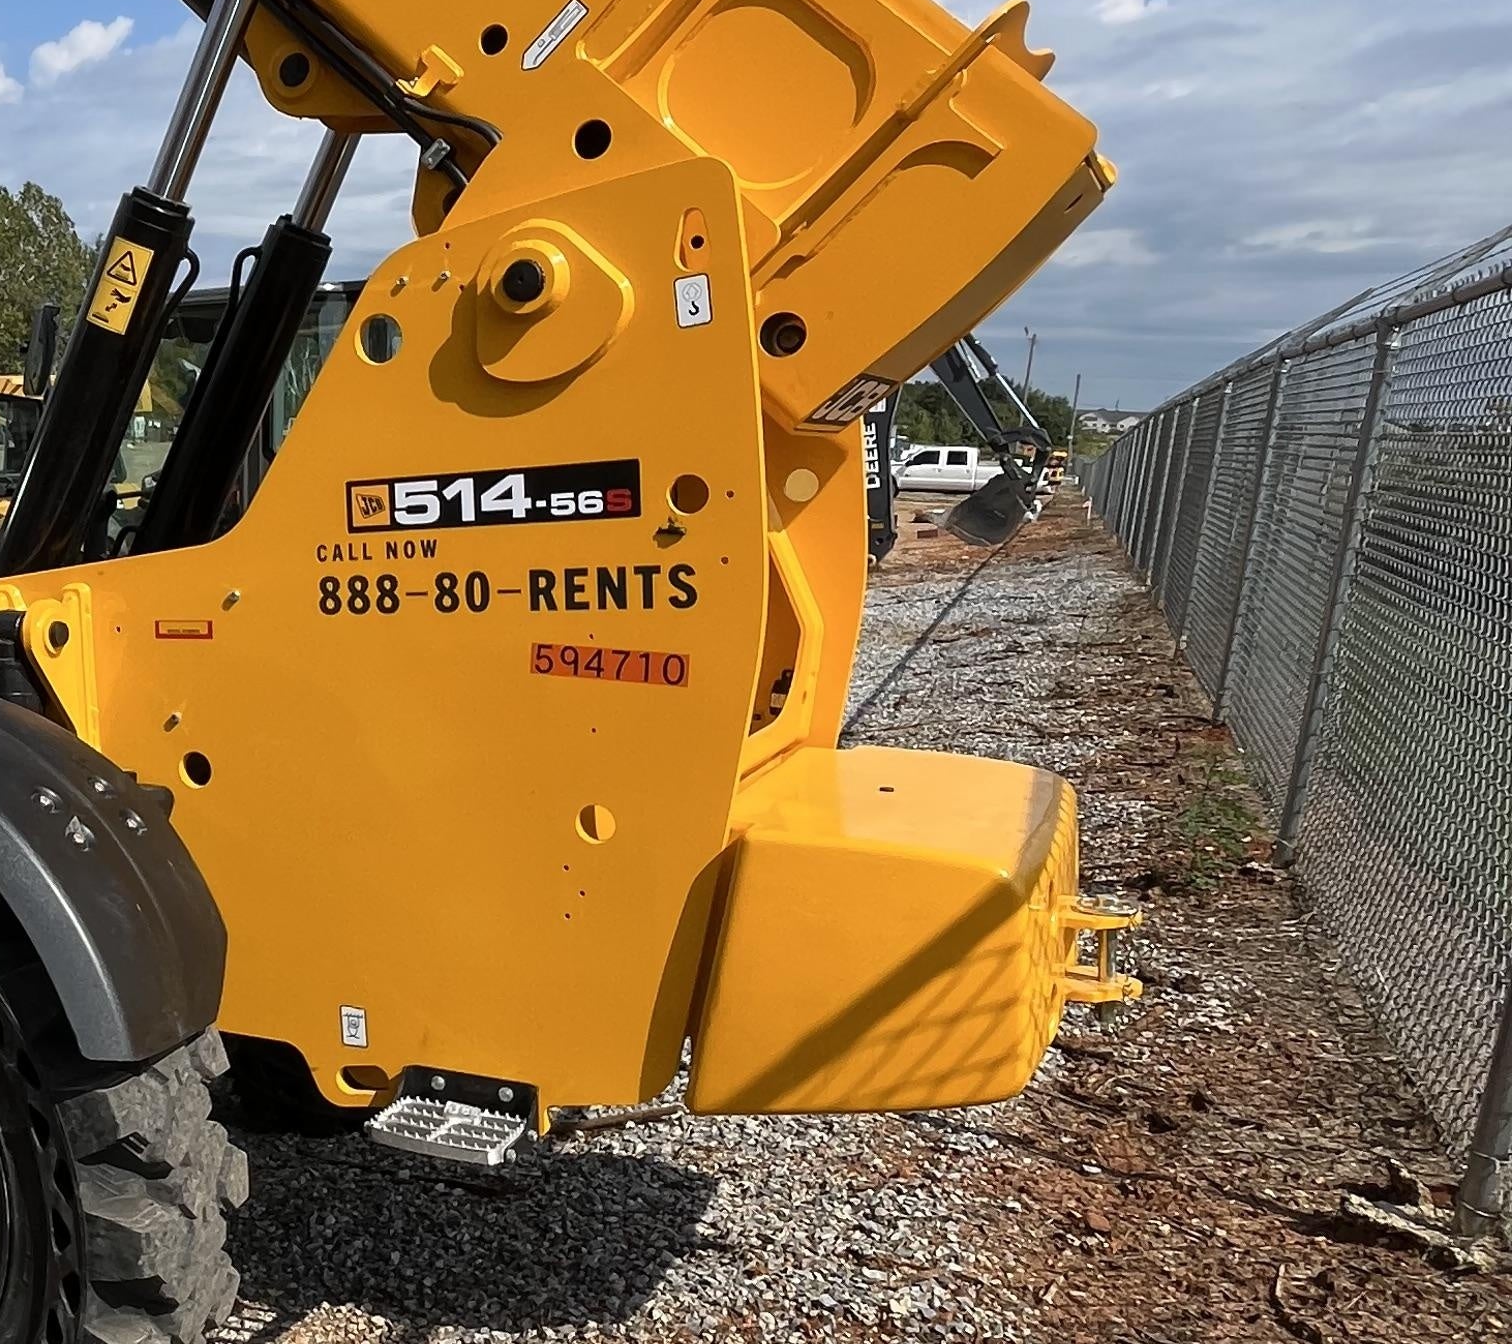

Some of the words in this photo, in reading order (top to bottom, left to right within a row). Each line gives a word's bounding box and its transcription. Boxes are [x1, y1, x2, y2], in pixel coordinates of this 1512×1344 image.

[812, 379, 890, 421] JCB
[863, 422, 881, 488] DEERE
[316, 542, 372, 562] CALL
[386, 539, 437, 559] NOW
[319, 564, 697, 615] 888-80-RENTS
[535, 644, 686, 685] 594710
